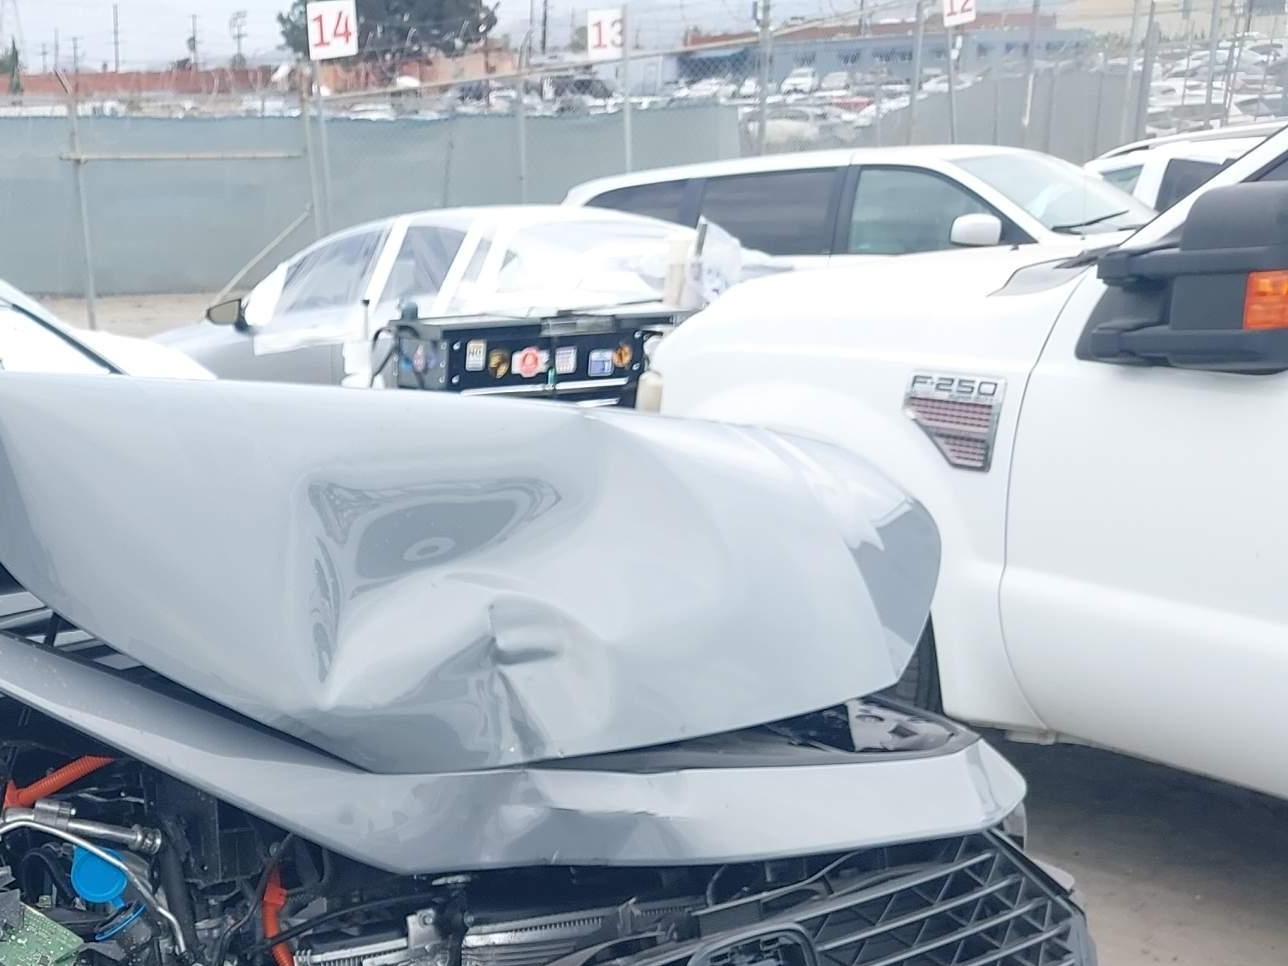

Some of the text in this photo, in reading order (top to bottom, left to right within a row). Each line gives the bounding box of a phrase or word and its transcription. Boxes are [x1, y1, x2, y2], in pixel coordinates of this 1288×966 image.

[313, 11, 352, 47] 14
[592, 18, 624, 48] 13
[912, 375, 998, 396] F-250
